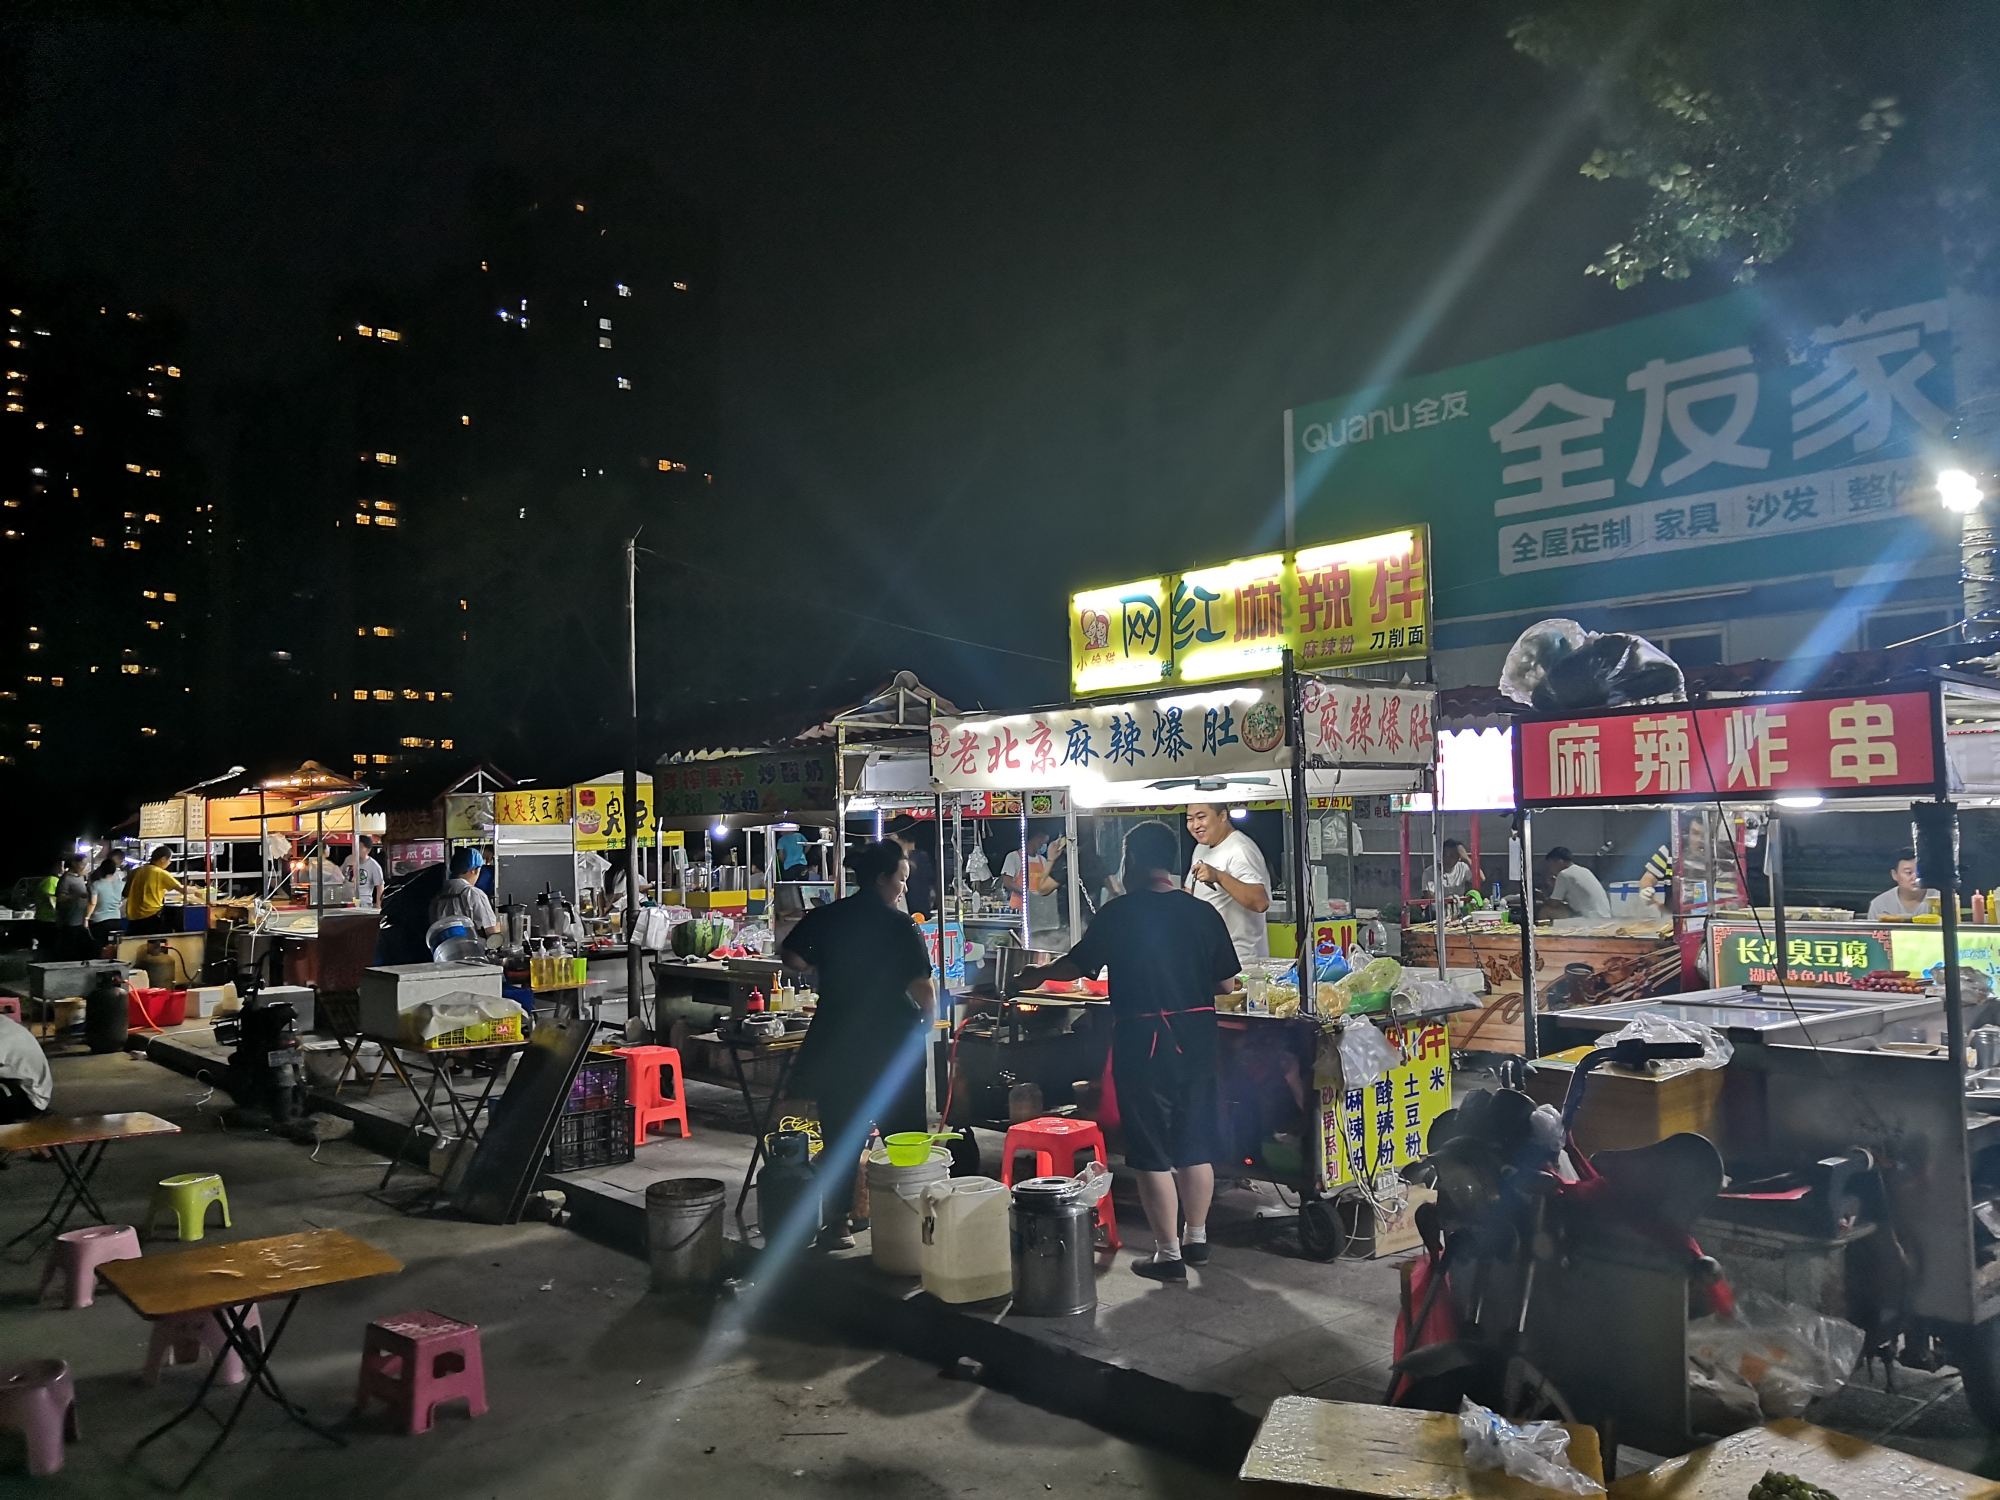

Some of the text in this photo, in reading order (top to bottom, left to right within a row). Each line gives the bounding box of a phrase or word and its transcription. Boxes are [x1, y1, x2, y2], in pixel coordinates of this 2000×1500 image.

[1413, 390, 1470, 429] 全友
[1511, 515, 1631, 564] 全屋定制
[1654, 502, 1721, 542] 家具
[1746, 486, 1820, 528] 沙发
[1302, 635, 1355, 659] 麻辣粉
[1369, 625, 1424, 650] 刀削面
[949, 706, 1240, 776] 老北京麻辣爆肚
[1316, 693, 1433, 755] 麻辣爆肚
[1549, 700, 1899, 796] 麻辣炸串
[1403, 1073, 1423, 1159] 土豆粉
